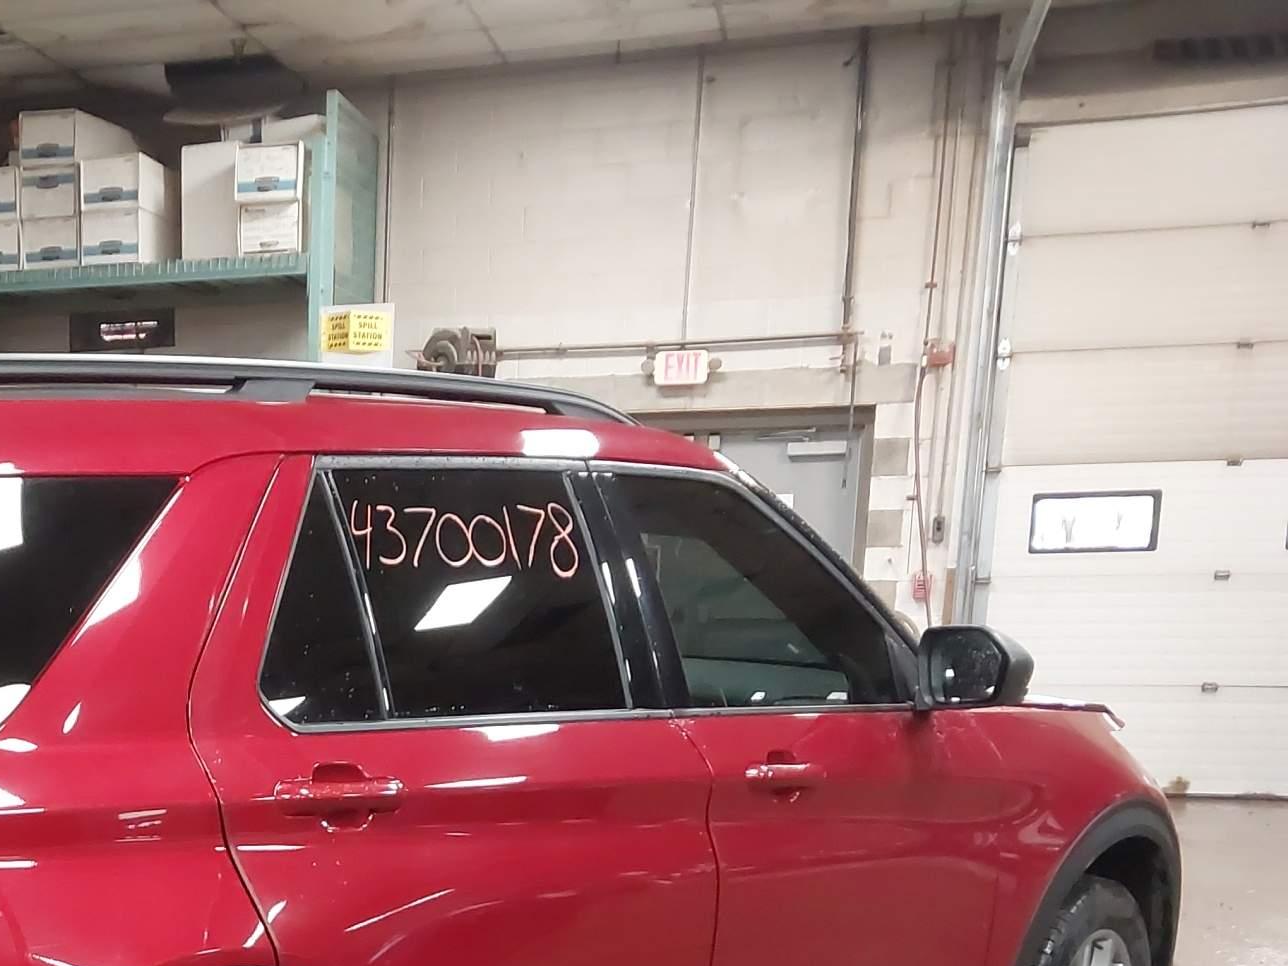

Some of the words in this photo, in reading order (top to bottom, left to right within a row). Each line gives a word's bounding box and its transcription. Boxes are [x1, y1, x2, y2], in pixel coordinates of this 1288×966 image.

[358, 321, 378, 329] SPILL
[353, 331, 383, 340] STATION
[664, 352, 702, 380] EXIT
[350, 499, 580, 578] 43700178
